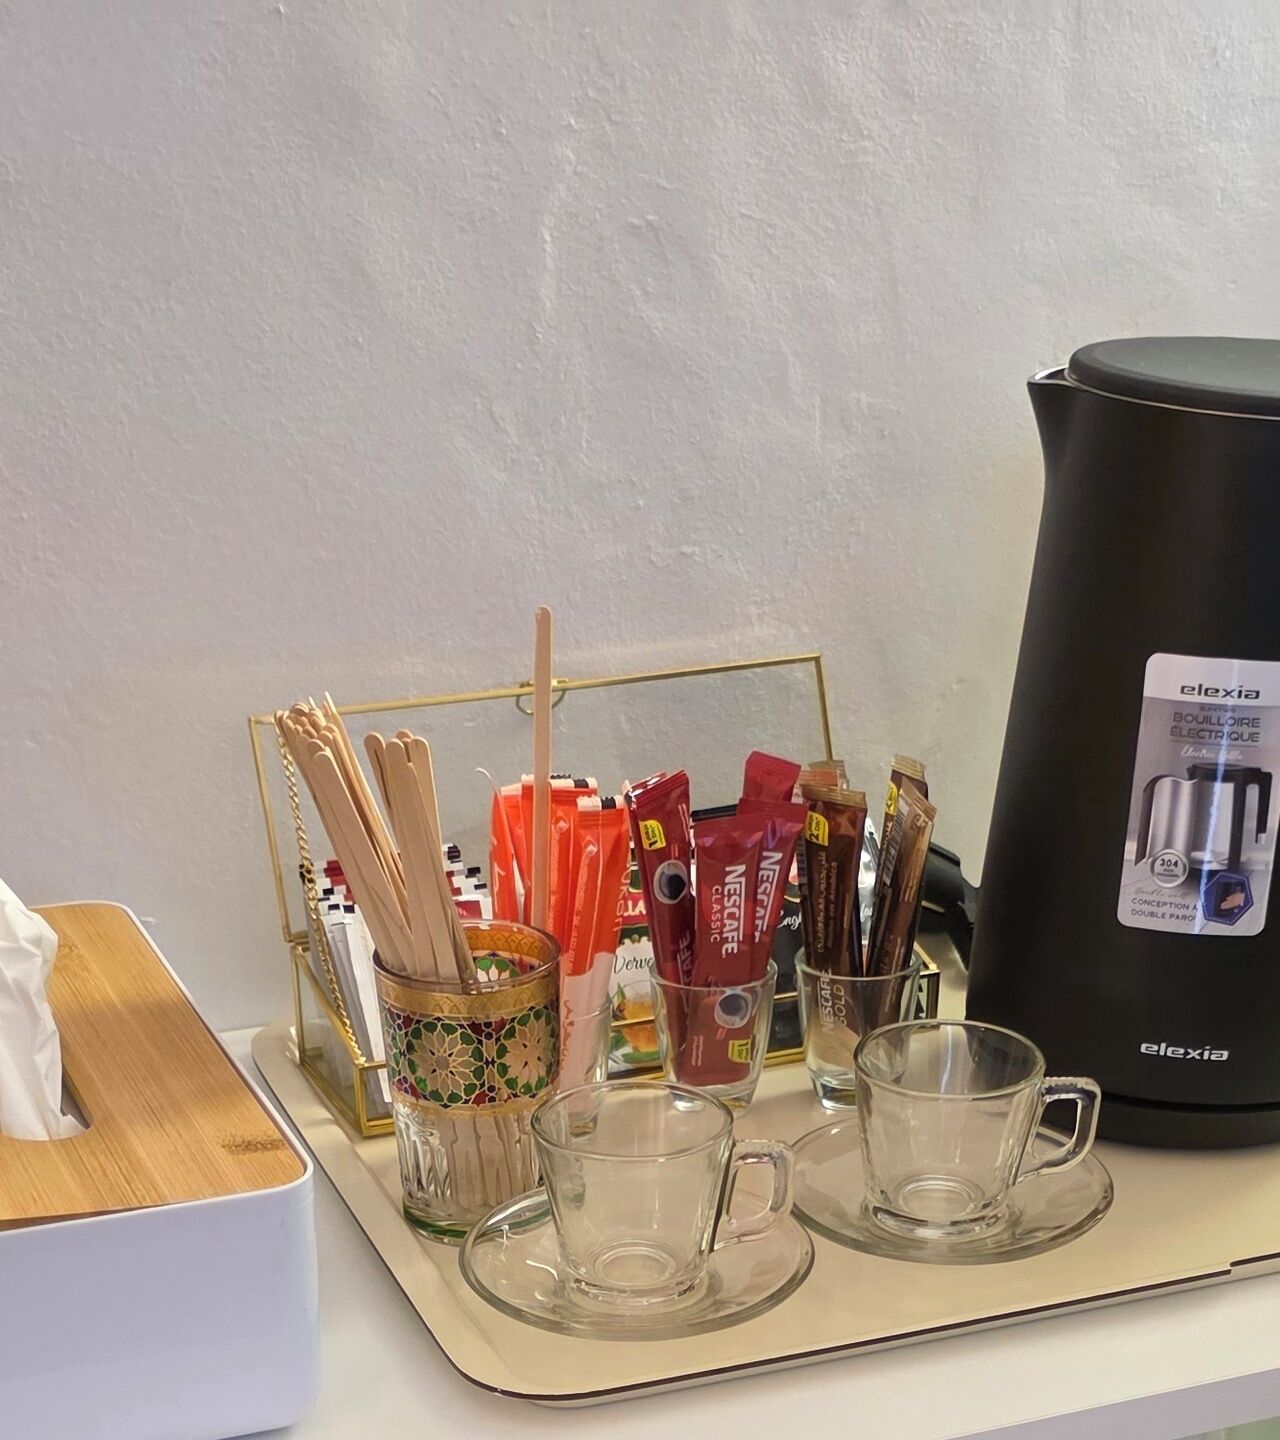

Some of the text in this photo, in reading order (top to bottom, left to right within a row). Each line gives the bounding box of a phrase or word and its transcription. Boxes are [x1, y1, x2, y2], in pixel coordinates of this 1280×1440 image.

[1180, 683, 1260, 700] elexia
[1173, 711, 1261, 729] BOUILLOIRE
[1169, 724, 1261, 743] ÉLECTRIQUE
[1159, 858, 1179, 868] 304
[1131, 897, 1190, 911] CONCEPTION
[711, 885, 722, 943] CLASSIC
[1131, 908, 1166, 920] DOUBLE
[833, 984, 847, 1028] GOLD
[1140, 1041, 1230, 1061] elexia
